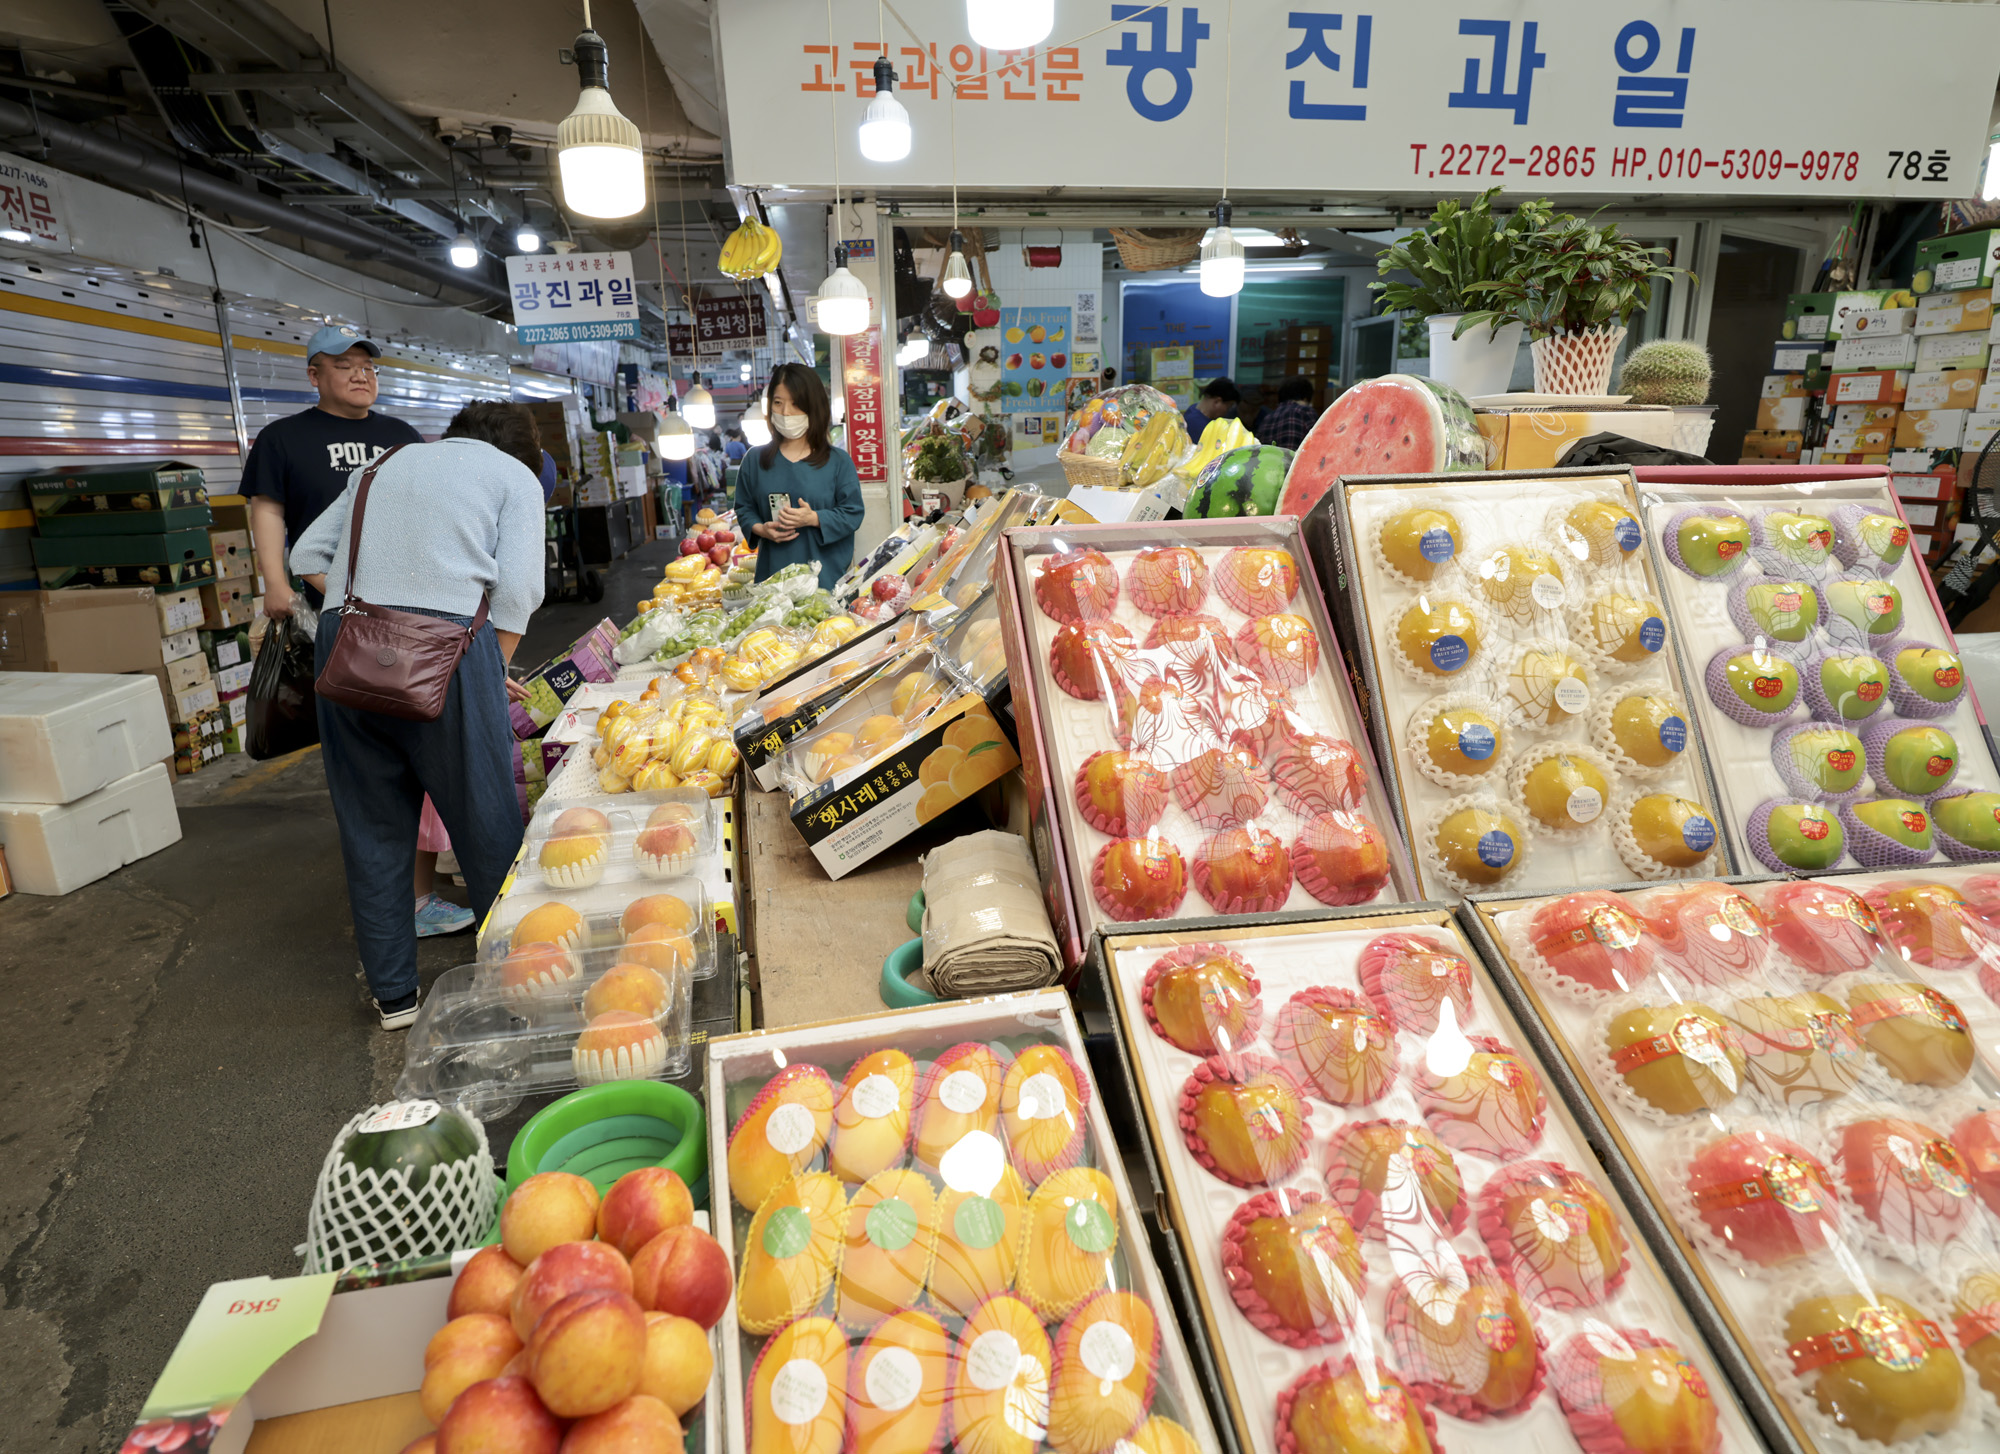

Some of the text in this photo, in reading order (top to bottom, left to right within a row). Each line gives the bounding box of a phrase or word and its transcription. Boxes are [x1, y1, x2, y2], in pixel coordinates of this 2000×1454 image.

[802, 43, 1083, 101] 고급과일전문
[1107, 5, 1695, 127] 광진과일
[1411, 144, 1950, 182] T.2272-2865 HP.010-5309-9978 78호
[514, 277, 633, 311] 광진과일
[700, 312, 762, 337] 동원청과
[1040, 311, 1067, 323] Fruit
[1166, 322, 1186, 333] THE
[524, 323, 634, 342] 2272-2865 010-5309-9978
[852, 375, 877, 424] 냉장고에
[1006, 395, 1037, 408] Fresh
[855, 428, 880, 478] 있습니다
[1436, 644, 1460, 652] PREMIUM
[872, 761, 908, 788] 장호원
[819, 782, 878, 830] 햇사레
[1485, 840, 1508, 848] PREMIUM
[228, 1298, 280, 1315] 5Kg
